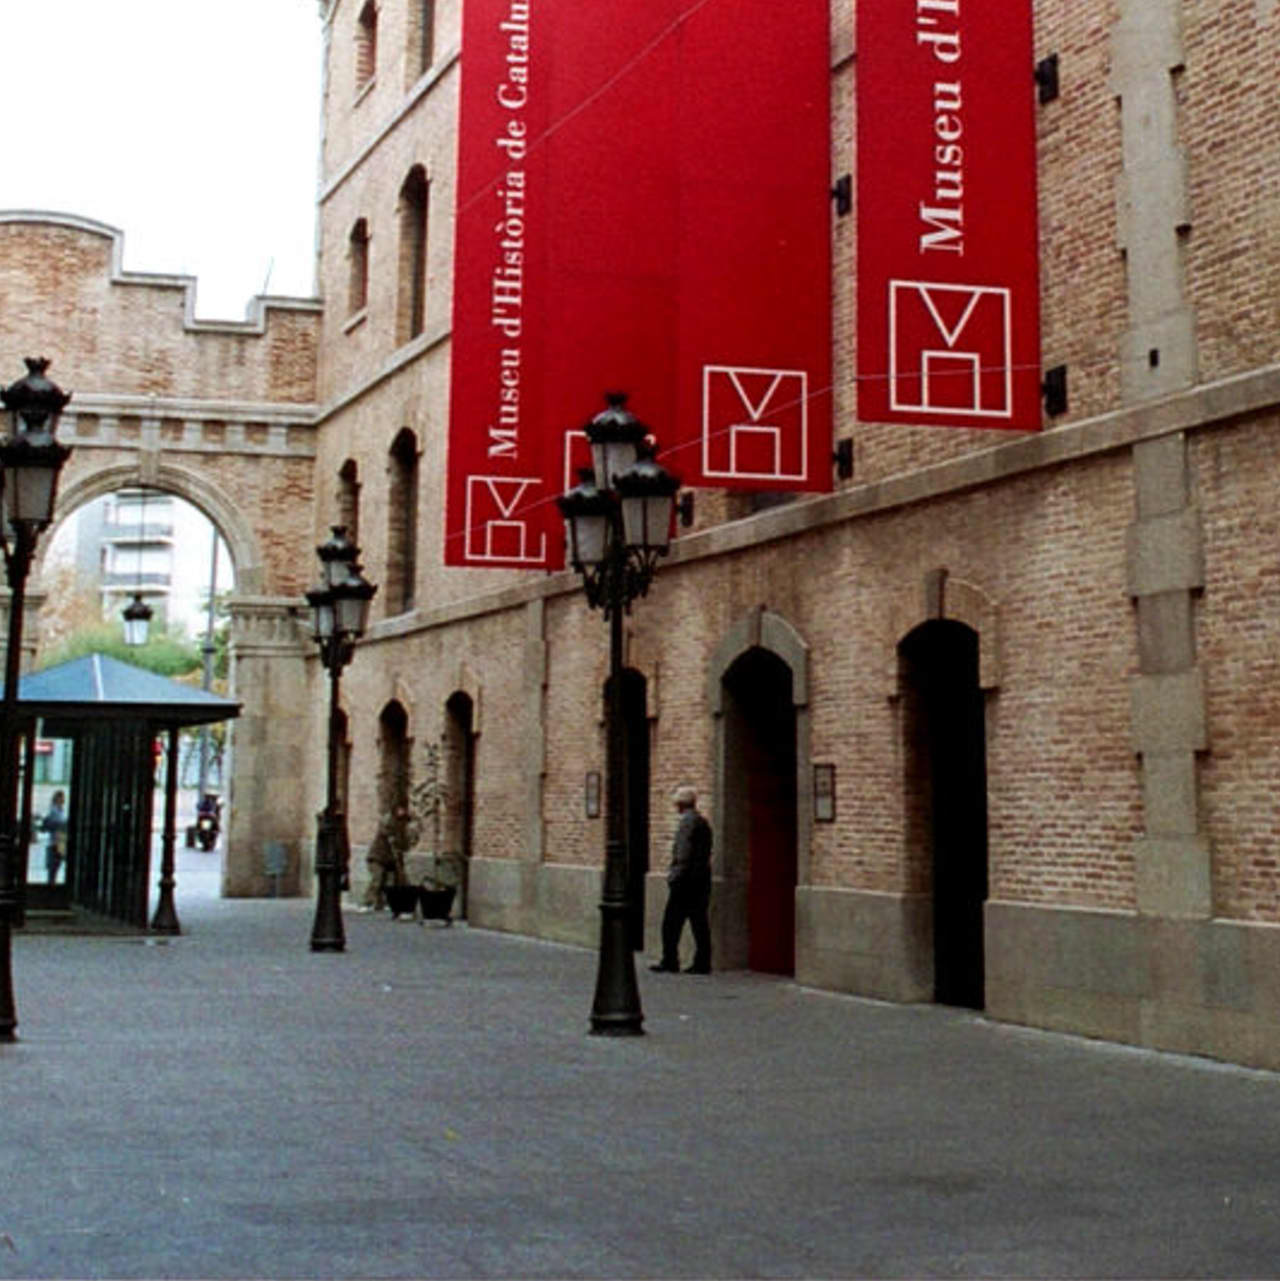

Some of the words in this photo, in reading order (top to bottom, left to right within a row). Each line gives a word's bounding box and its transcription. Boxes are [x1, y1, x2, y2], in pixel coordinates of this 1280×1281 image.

[495, 120, 527, 160] de
[919, 81, 964, 255] Museu
[492, 170, 526, 338] d'Història
[488, 349, 521, 459] Museu
